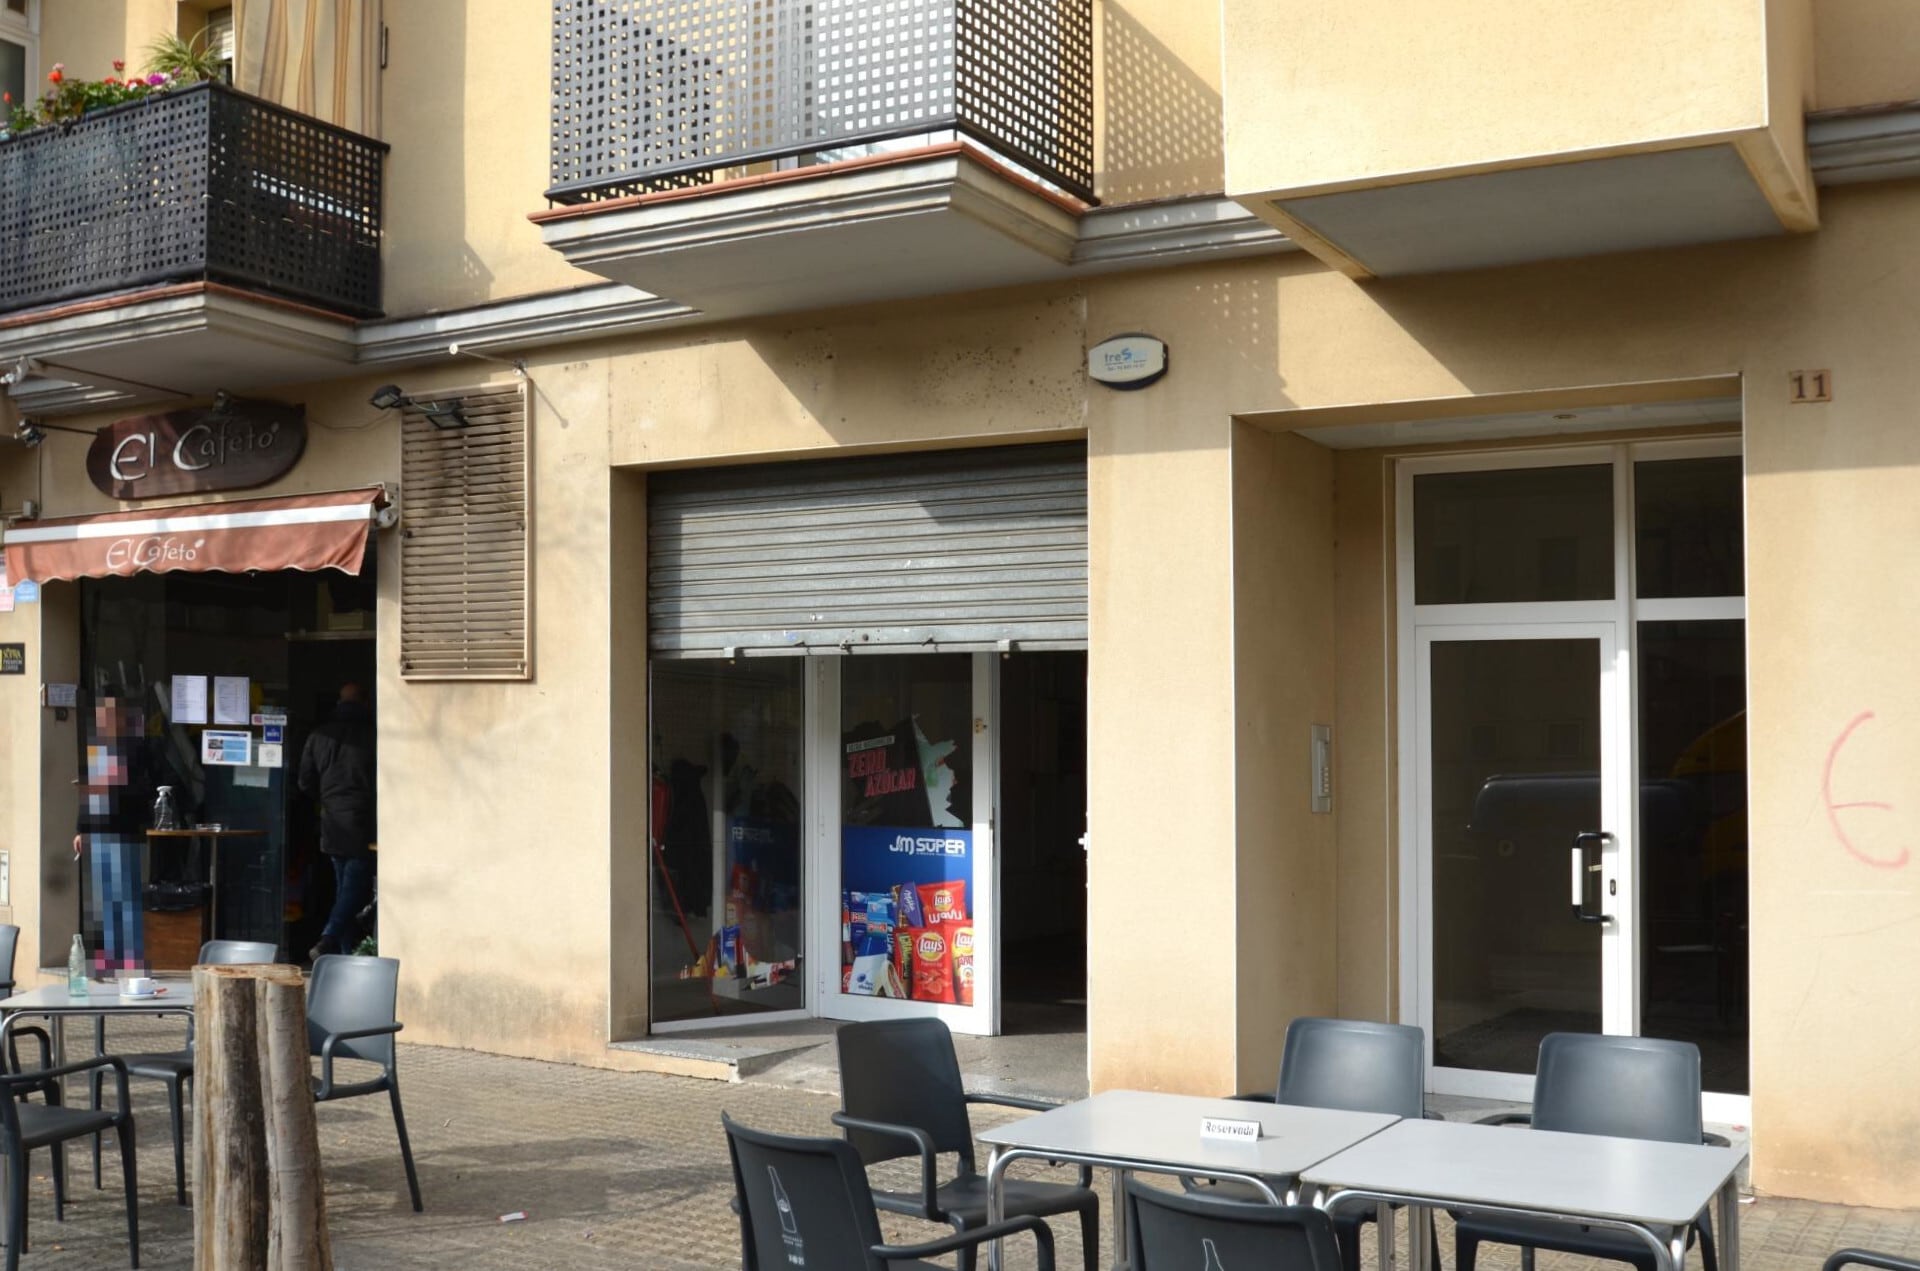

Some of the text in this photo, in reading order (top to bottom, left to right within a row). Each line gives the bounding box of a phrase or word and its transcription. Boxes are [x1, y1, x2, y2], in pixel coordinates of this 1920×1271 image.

[1793, 374, 1827, 399] 11
[110, 424, 276, 481] El Cafeto
[106, 535, 198, 569] El Cafeto
[890, 835, 966, 855] JM SUPER
[920, 938, 943, 952] Lay's
[1206, 1121, 1254, 1136] Reservado
